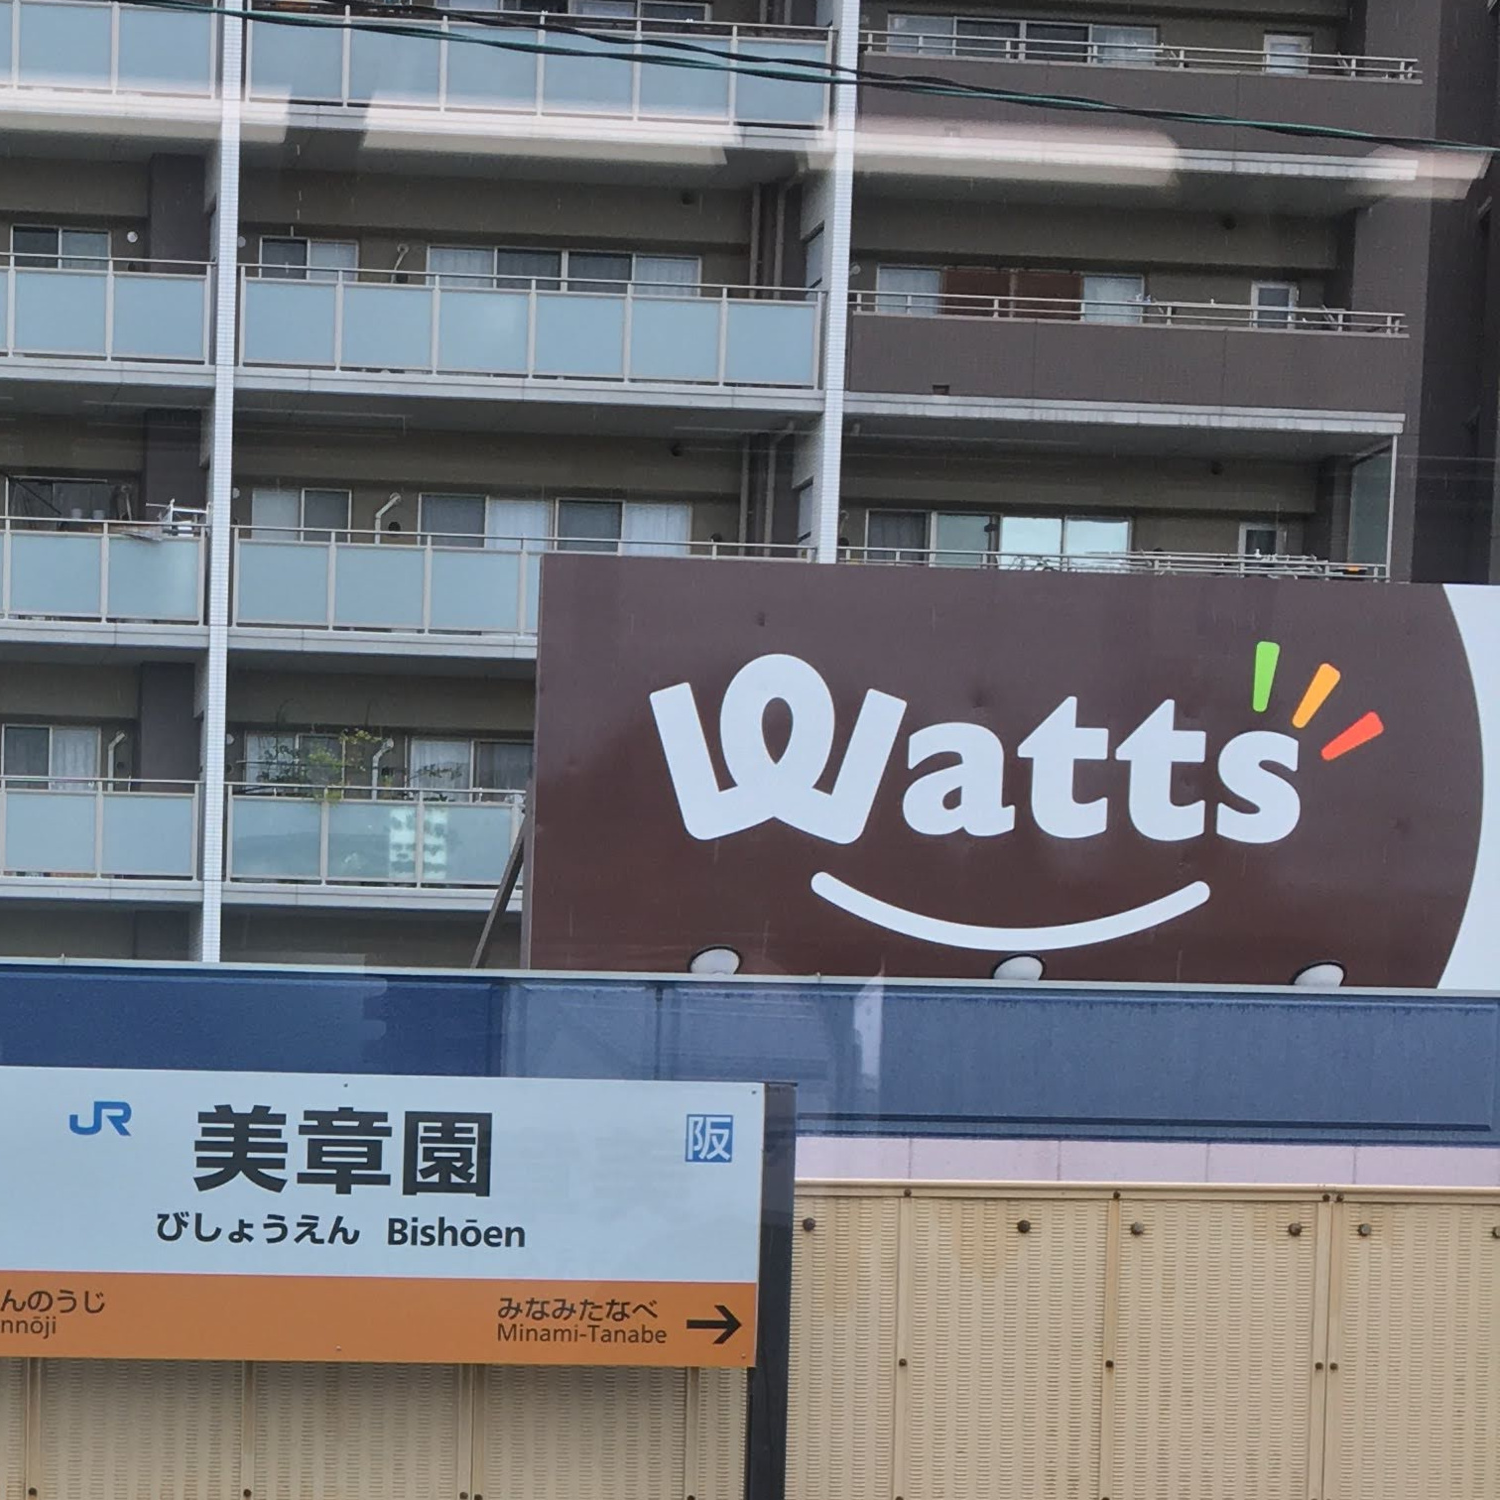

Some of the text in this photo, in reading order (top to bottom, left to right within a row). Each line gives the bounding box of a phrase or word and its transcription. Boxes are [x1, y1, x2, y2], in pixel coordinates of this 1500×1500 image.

[649, 652, 1301, 845] Watts
[68, 1100, 133, 1137] JR
[193, 1104, 493, 1198] 美章園
[686, 1115, 732, 1161] 阪
[156, 1211, 525, 1249] びしょうえん Bishōen
[497, 1297, 659, 1321] みなみたなべ
[497, 1323, 667, 1344] Minami-Tanabe
